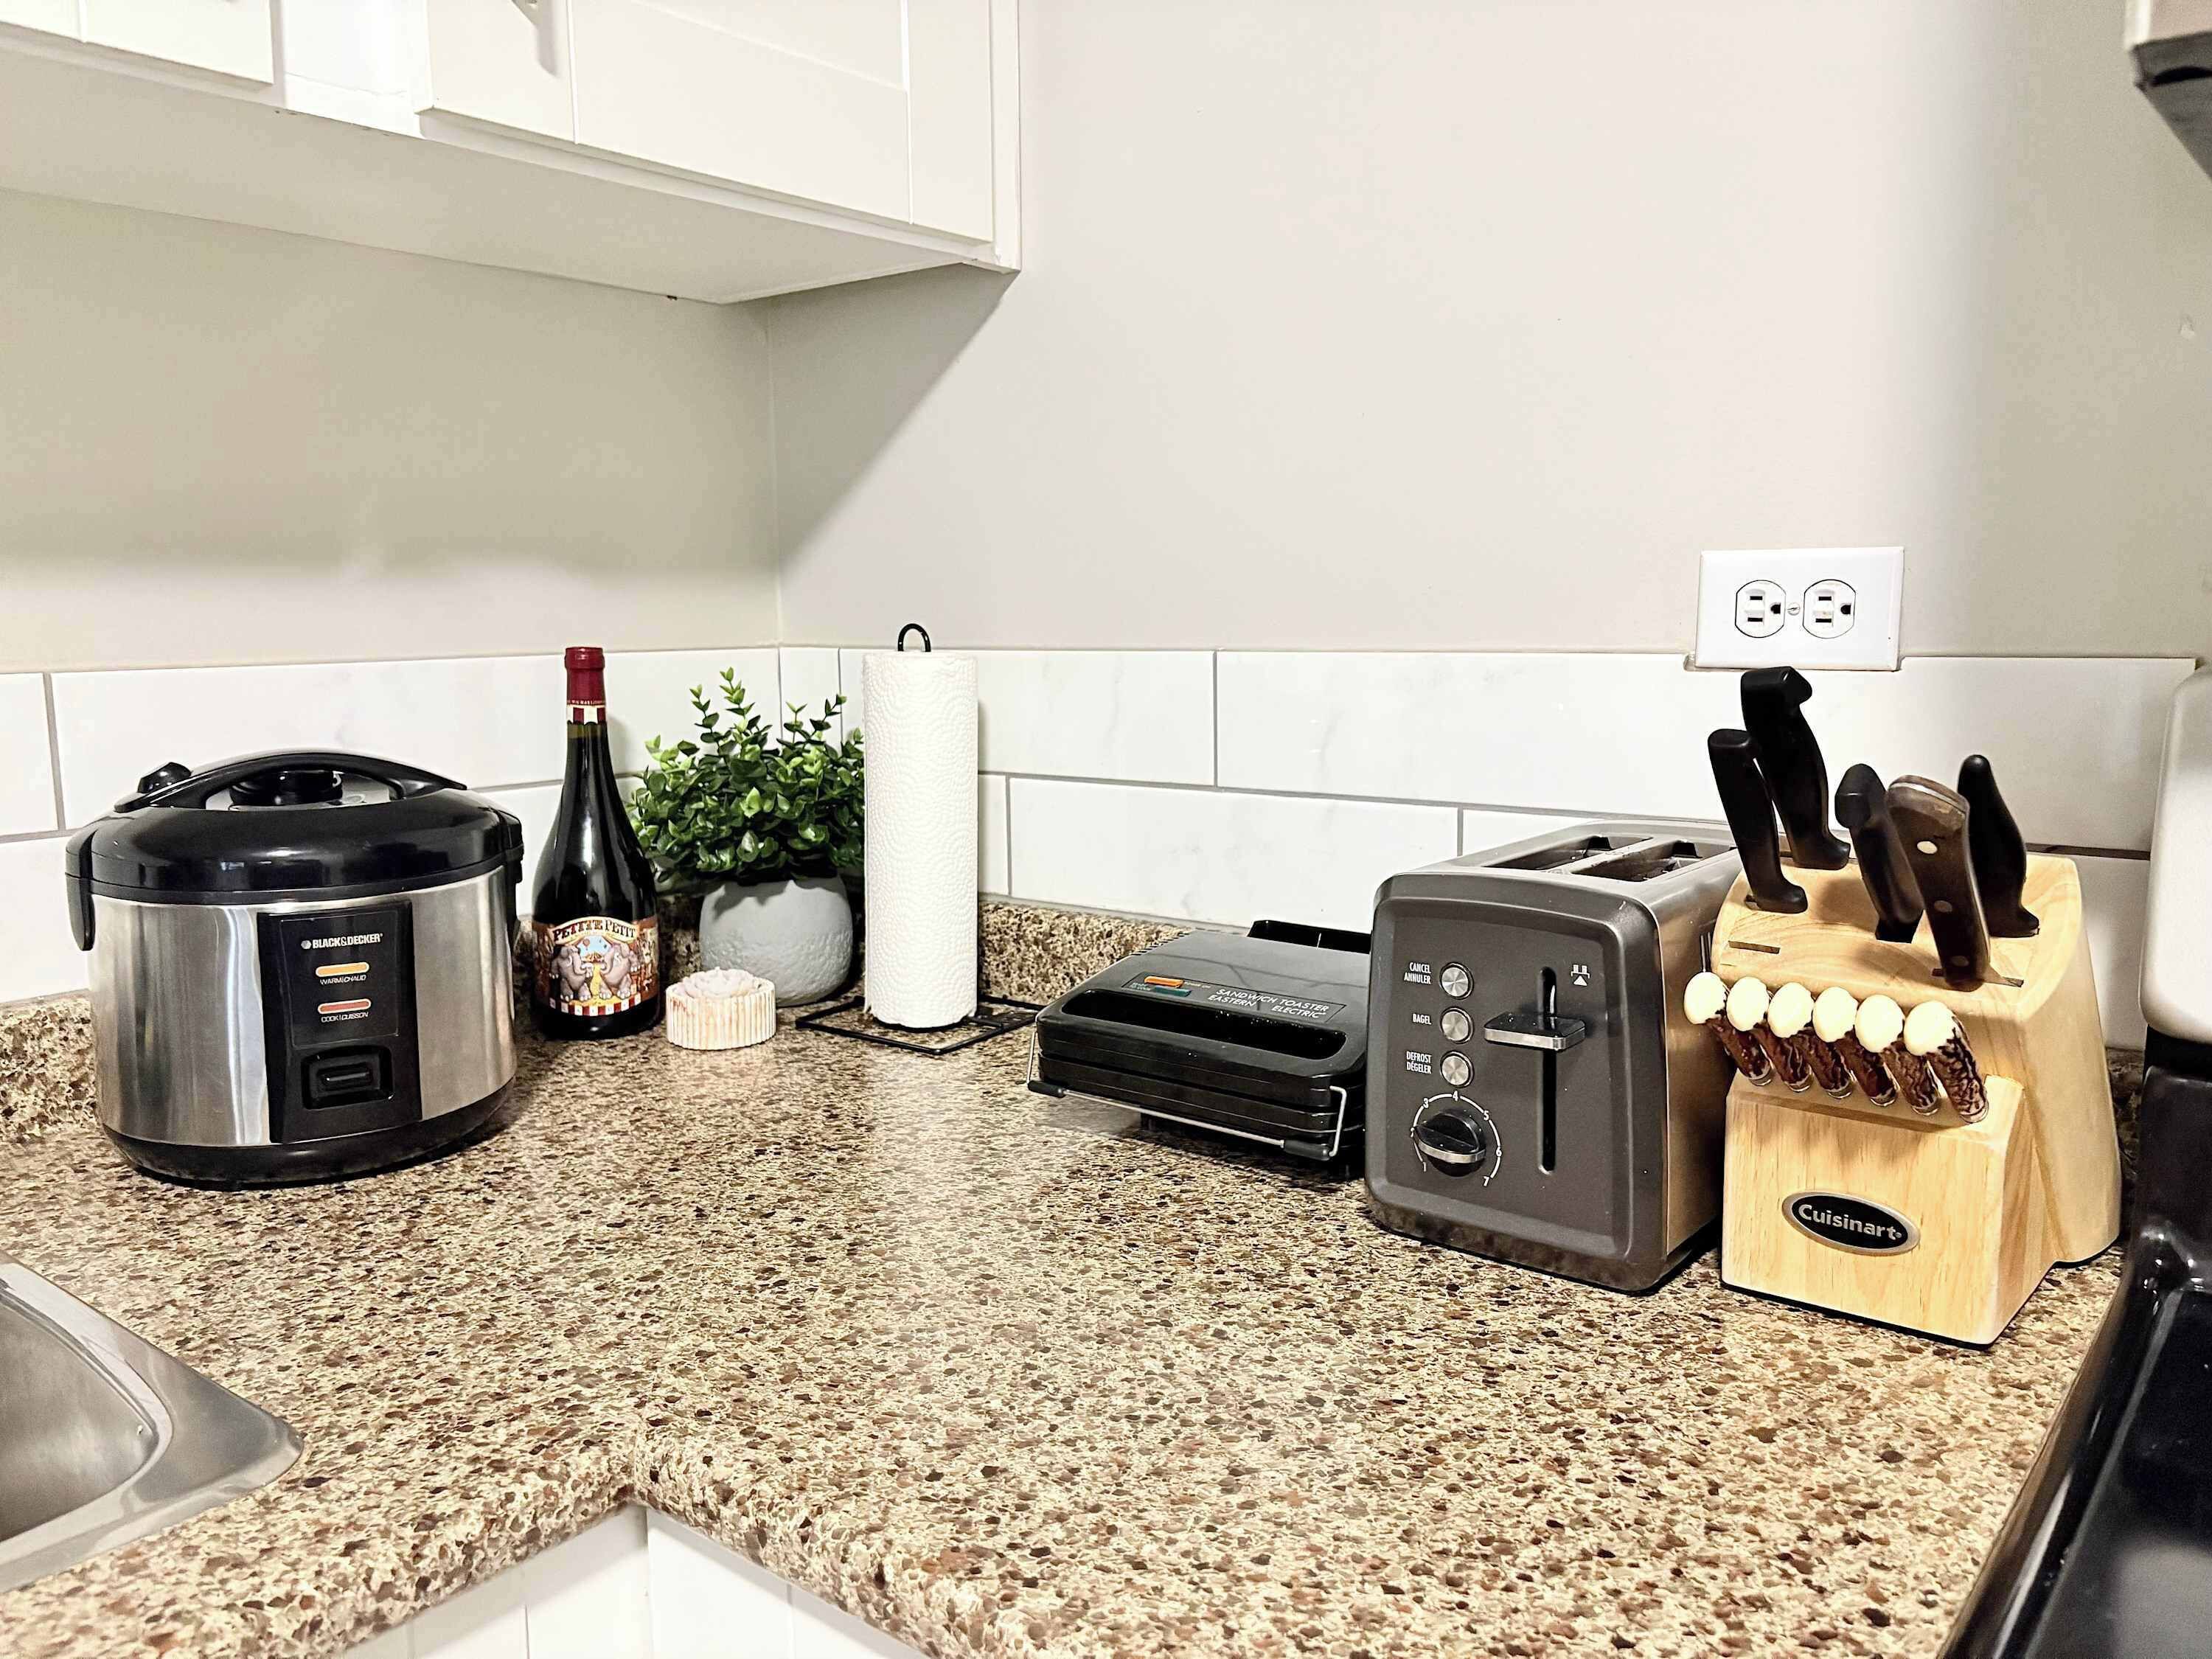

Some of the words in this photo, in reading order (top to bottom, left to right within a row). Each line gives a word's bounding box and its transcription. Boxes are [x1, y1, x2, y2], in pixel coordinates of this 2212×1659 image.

[552, 919, 603, 942] PETITE
[605, 919, 636, 938] PETIT
[312, 933, 382, 949] BLACK&DECKER
[1409, 961, 1432, 974] CANCEL
[1403, 972, 1431, 984] ANNULER
[1207, 994, 1257, 1007] EASTERN
[1216, 988, 1278, 1004] SANDWICH
[1279, 998, 1330, 1012] TOASTER
[1412, 1013, 1432, 1025] BAGEL
[1406, 1051, 1432, 1064] DEFROST
[1406, 1061, 1432, 1074] DÉGELER
[1452, 1090, 1458, 1102] 4
[1422, 1097, 1429, 1109] 3
[1483, 1110, 1489, 1121] 5
[1495, 1146, 1503, 1157] 6
[1422, 1161, 1427, 1172] 1
[1483, 1175, 1490, 1186] 7
[1798, 1203, 1898, 1241] Cuisinart
